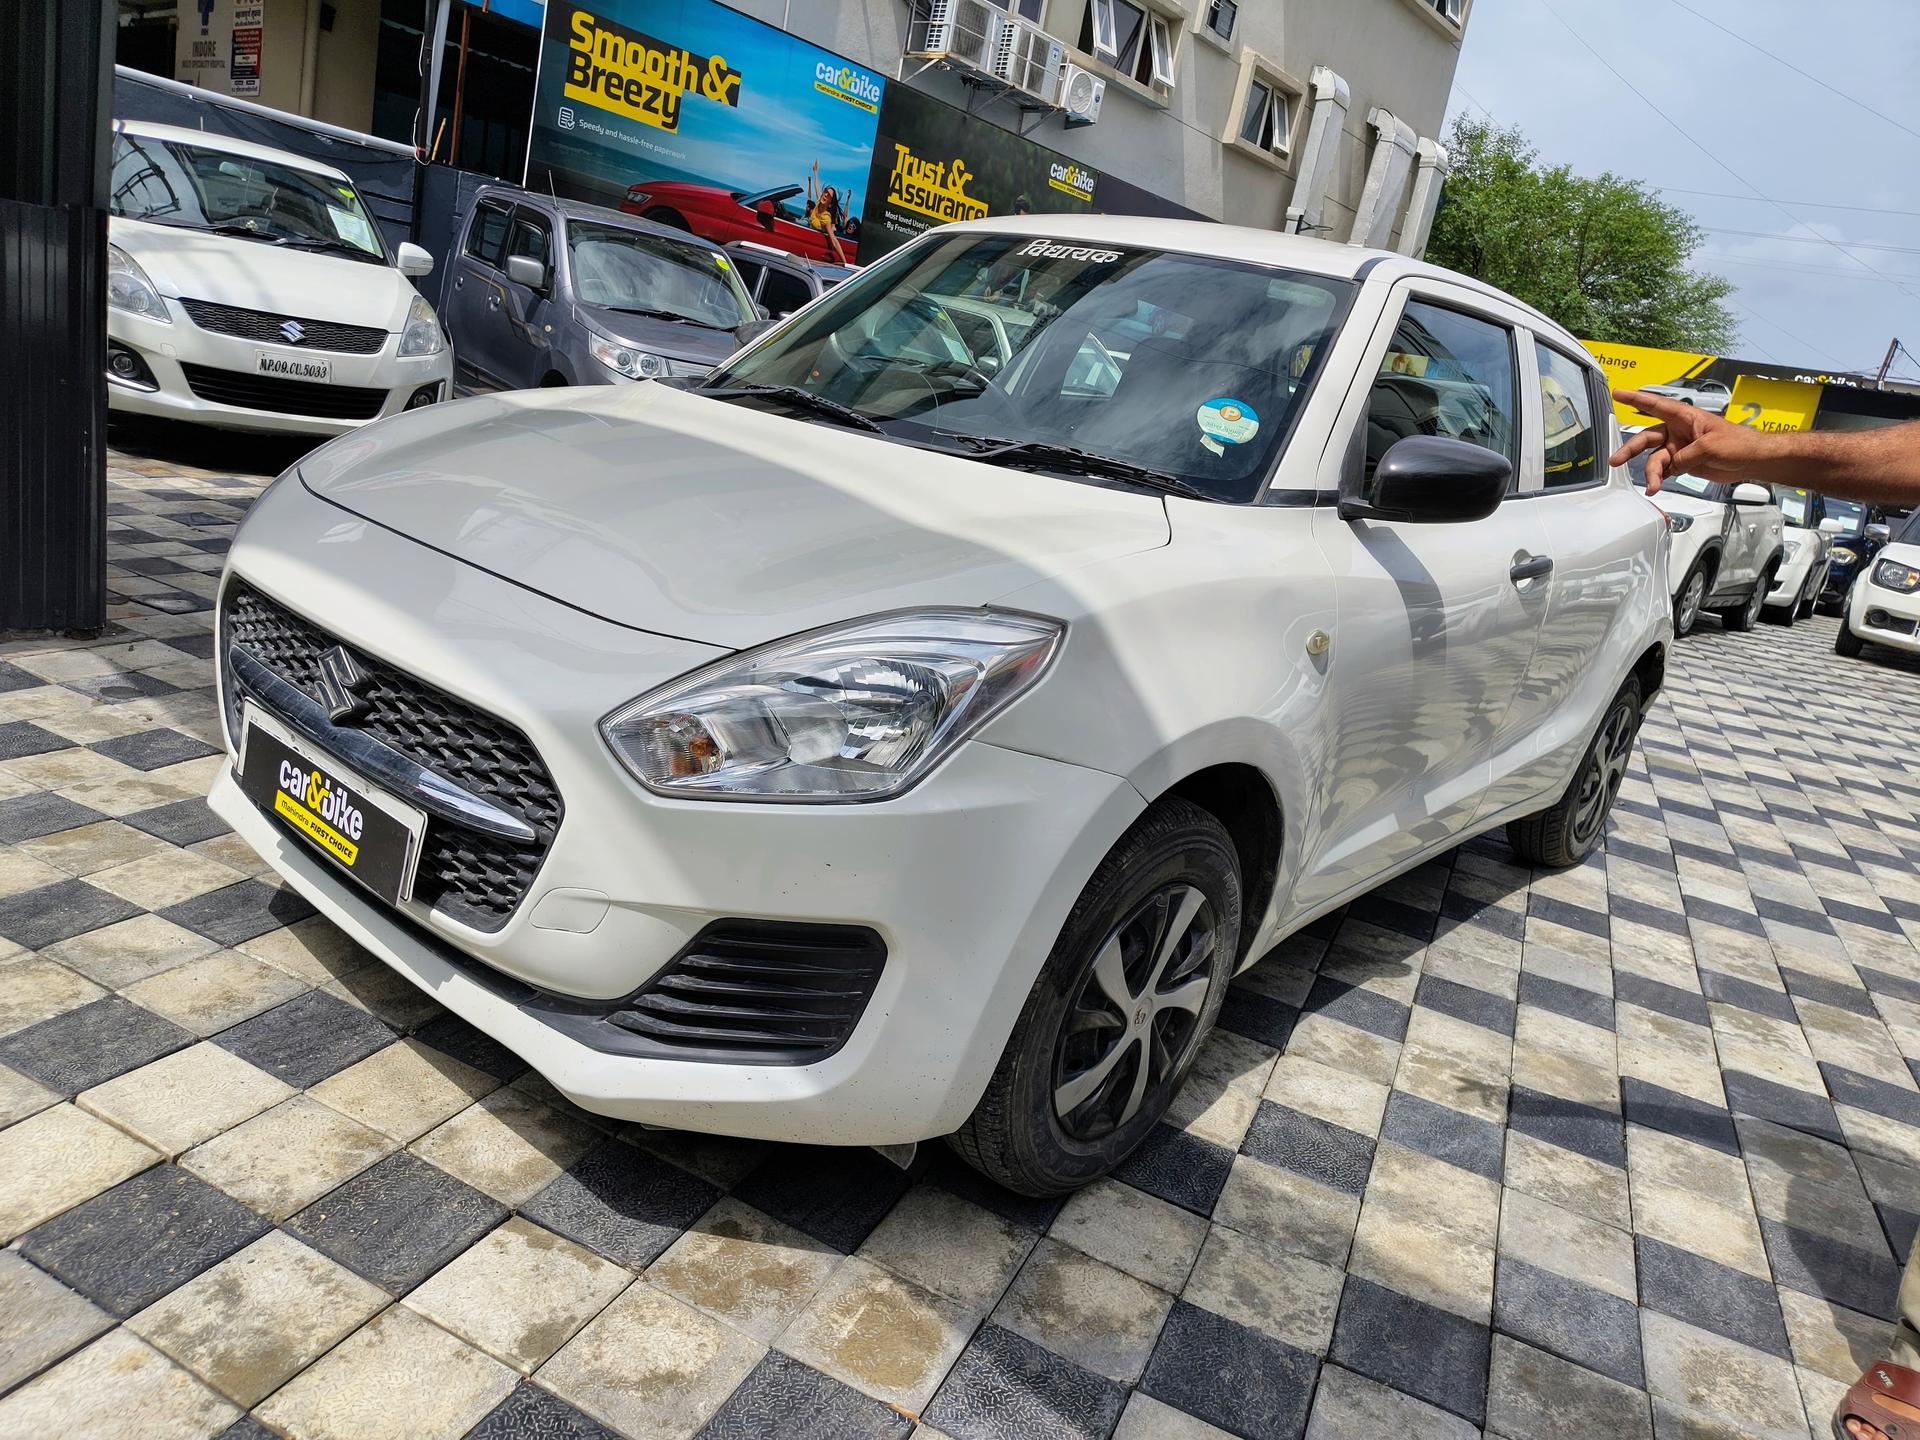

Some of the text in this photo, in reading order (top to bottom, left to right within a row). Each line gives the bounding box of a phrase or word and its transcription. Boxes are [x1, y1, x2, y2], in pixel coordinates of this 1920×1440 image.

[192, 41, 216, 57] INDORE
[569, 11, 741, 106] Smooth &
[566, 51, 682, 130] Breezy
[815, 62, 880, 103] car&bike
[579, 119, 604, 135] Speedy
[605, 128, 618, 139] and
[619, 132, 653, 150] hassle-free
[894, 143, 973, 197] Trust &
[1050, 163, 1094, 192] car&bike
[889, 172, 985, 221] Assurance
[885, 210, 898, 221] Most
[912, 219, 924, 230] Used
[886, 221, 894, 231] By
[894, 223, 918, 236] Franchise
[1016, 239, 1124, 263] विधायक
[1595, 354, 1637, 370] hange
[1740, 402, 1797, 433] 2 YEARS
[279, 759, 364, 841] car&bike
[310, 823, 329, 840] FIRST
[329, 836, 353, 859] CHOICE
